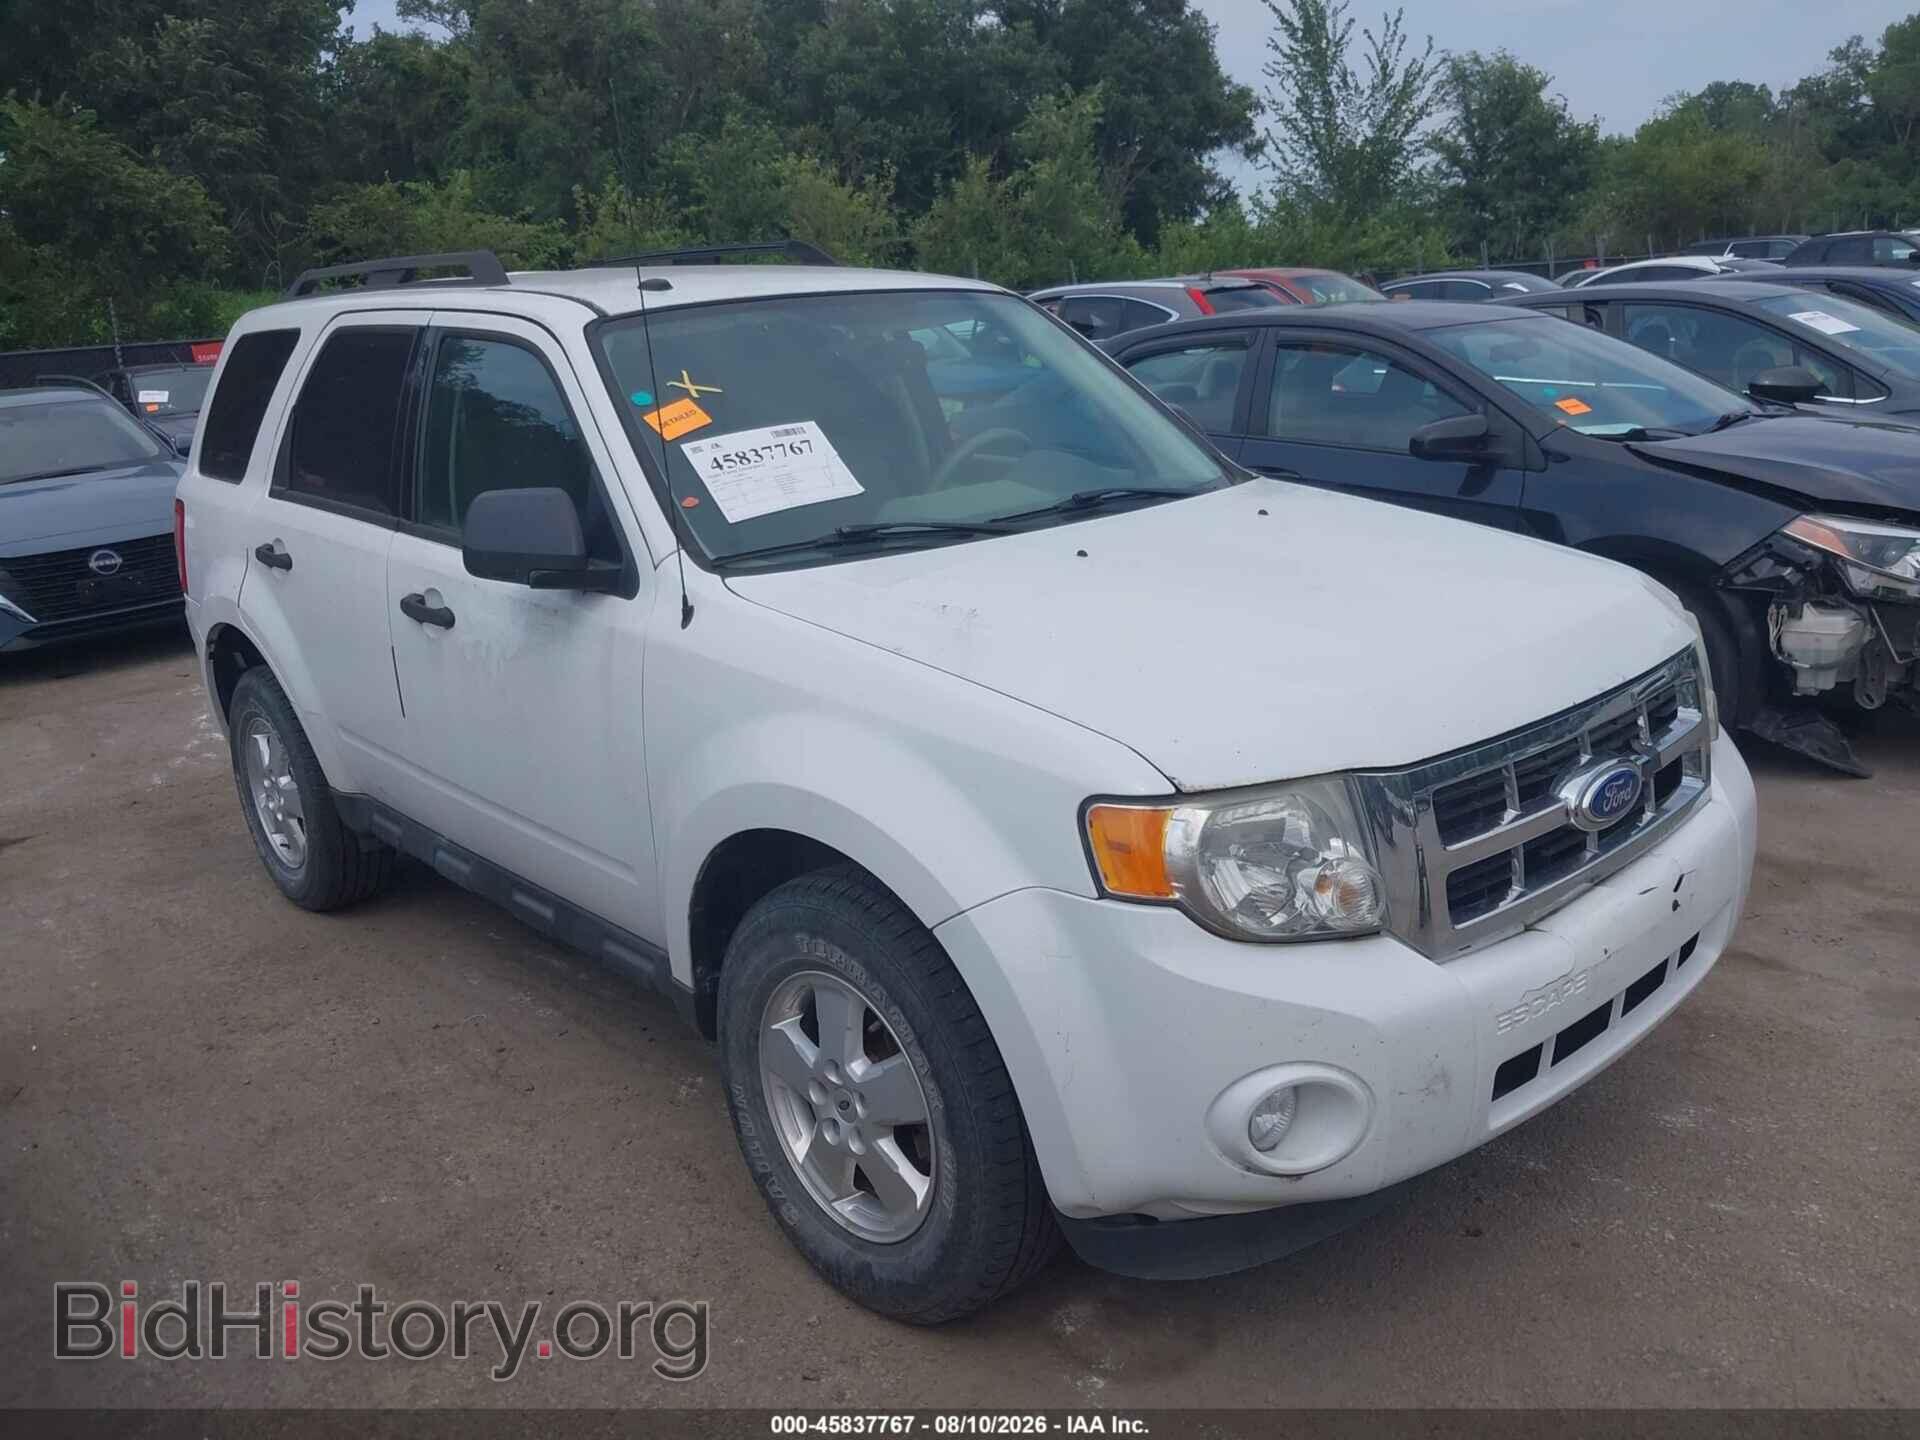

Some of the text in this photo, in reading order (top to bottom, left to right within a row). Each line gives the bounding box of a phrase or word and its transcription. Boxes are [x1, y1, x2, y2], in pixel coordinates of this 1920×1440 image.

[711, 439, 813, 470] 45837767
[1603, 779, 1633, 811] Ford
[1497, 973, 1588, 1035] ESCAPE
